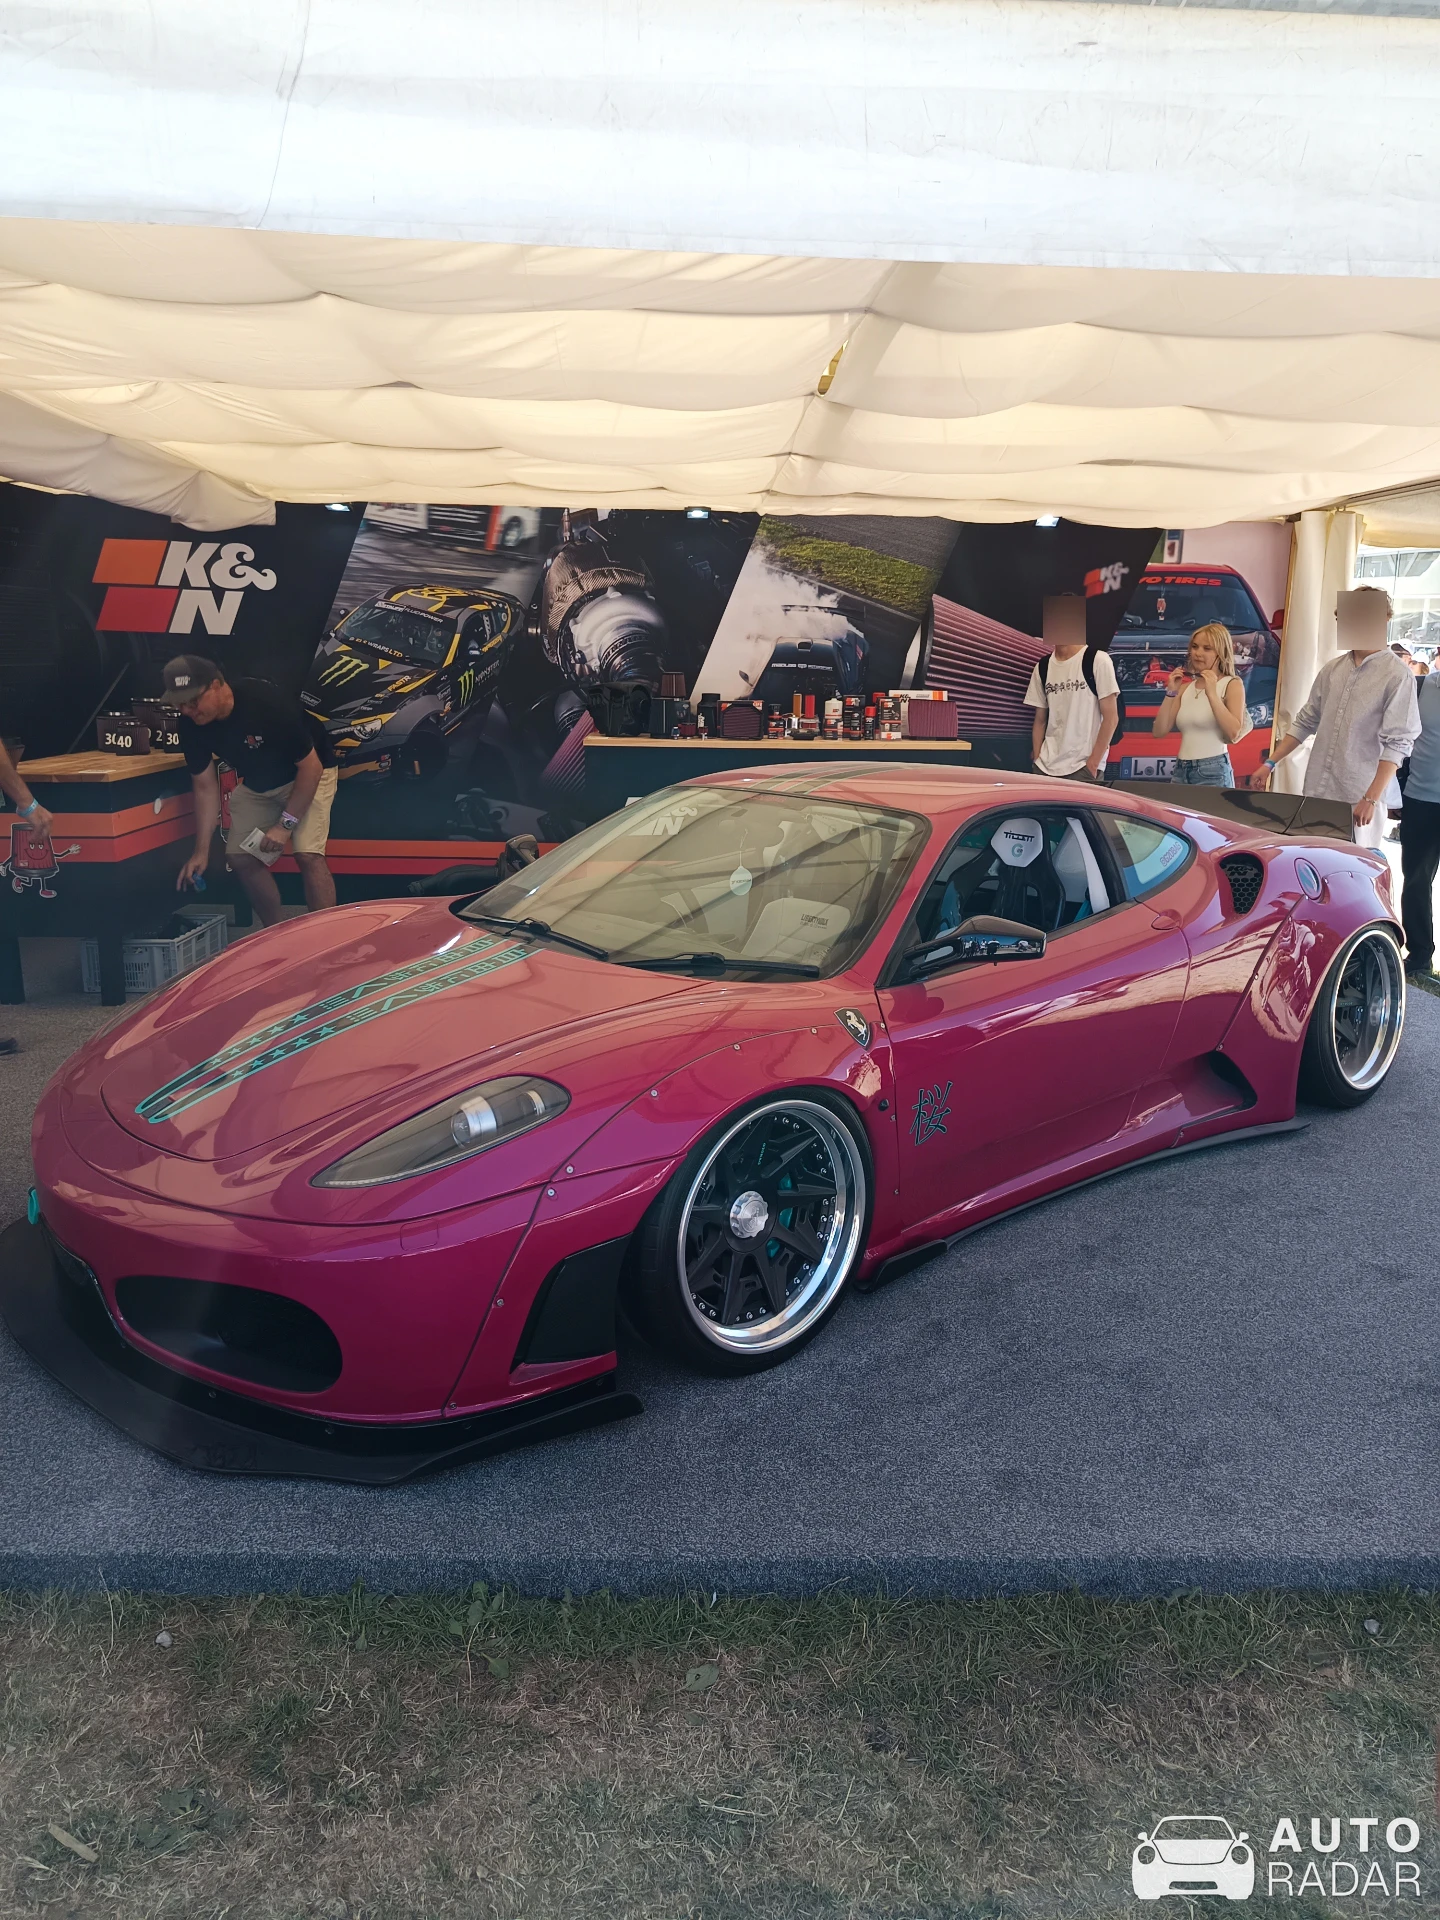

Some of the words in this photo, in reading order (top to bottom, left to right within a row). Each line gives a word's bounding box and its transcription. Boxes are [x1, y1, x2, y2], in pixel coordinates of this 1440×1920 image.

[1163, 576, 1222, 586] TIRES
[367, 641, 389, 653] WRAPS
[388, 648, 403, 658] LTD
[117, 735, 133, 748] 40
[166, 732, 180, 745] 30
[909, 1080, 953, 1146] 桜
